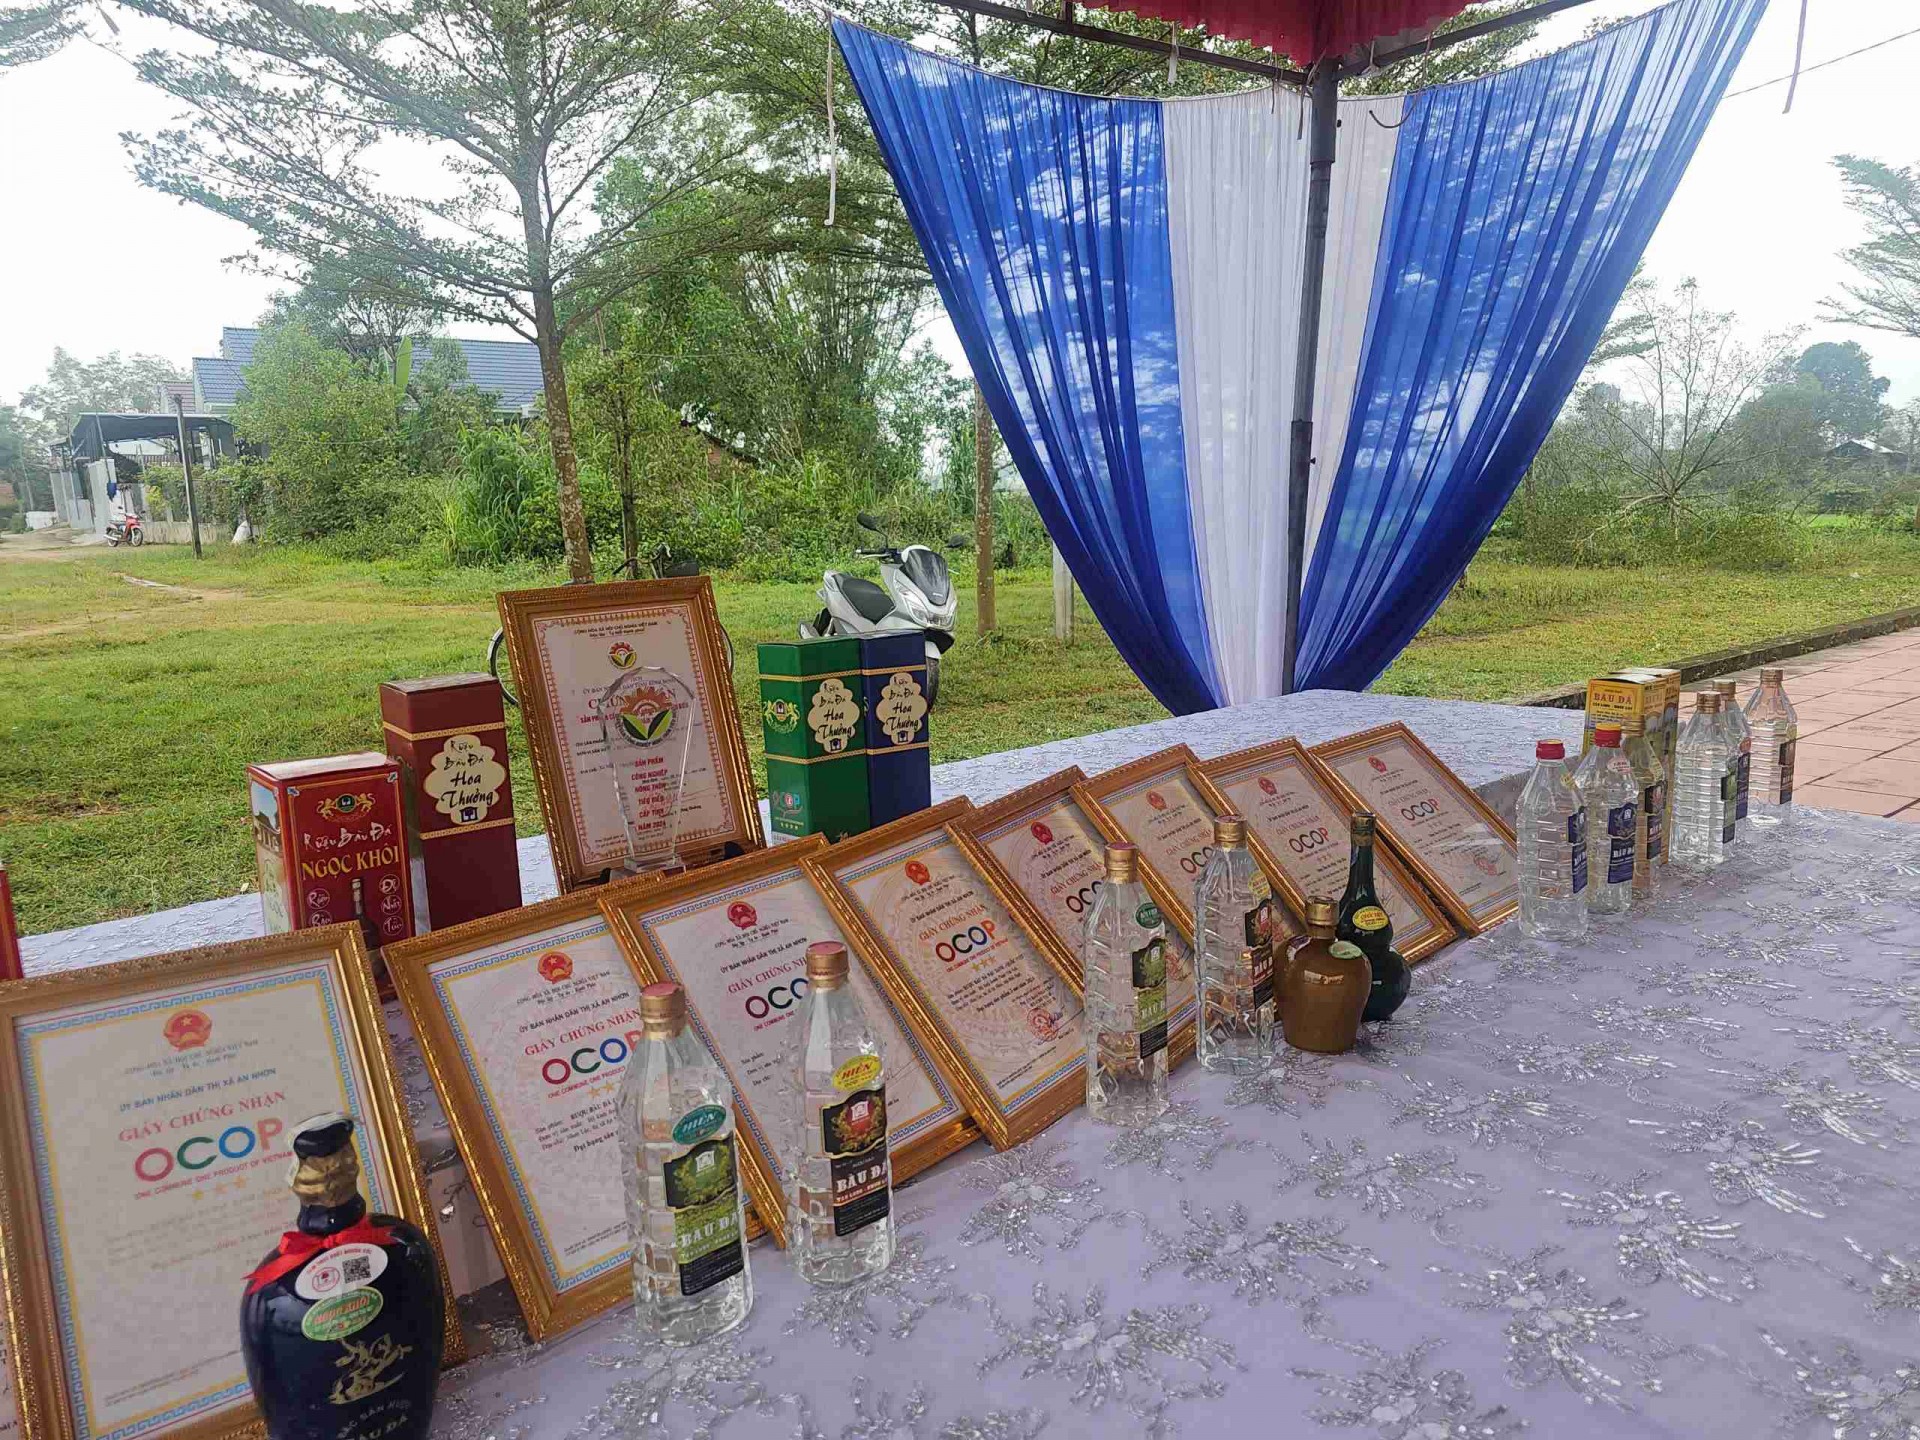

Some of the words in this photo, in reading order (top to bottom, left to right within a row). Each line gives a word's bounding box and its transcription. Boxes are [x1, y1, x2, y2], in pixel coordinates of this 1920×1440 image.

[824, 709, 844, 721] Hoa
[892, 702, 912, 713] Hoa
[450, 771, 481, 787] Hoa
[441, 788, 493, 808] Thưởng
[1401, 798, 1440, 821] OCOP
[370, 822, 393, 841] Đá
[1289, 827, 1329, 853] OCOP
[302, 854, 352, 881] NGỌC
[356, 842, 400, 871] KHÔI
[1181, 846, 1214, 874] OCO
[935, 919, 996, 962] OCOP
[727, 975, 754, 995] GIẤY
[755, 962, 792, 984] CHỨNG
[745, 977, 809, 1019] OCO
[530, 1020, 544, 1030] BAN
[545, 1014, 564, 1025] NHÂN
[601, 998, 611, 1006] AN
[524, 1038, 556, 1056] GIẤY
[559, 1020, 605, 1044] CHỨNG
[606, 1008, 641, 1028] NHẬN
[237, 1073, 249, 1083] AN
[118, 1120, 163, 1142] GIẤY
[169, 1103, 234, 1129] CHỨNG
[238, 1090, 286, 1111] NHẬN
[135, 1118, 283, 1182] OCOP
[213, 1163, 249, 1178] PRODUCT
